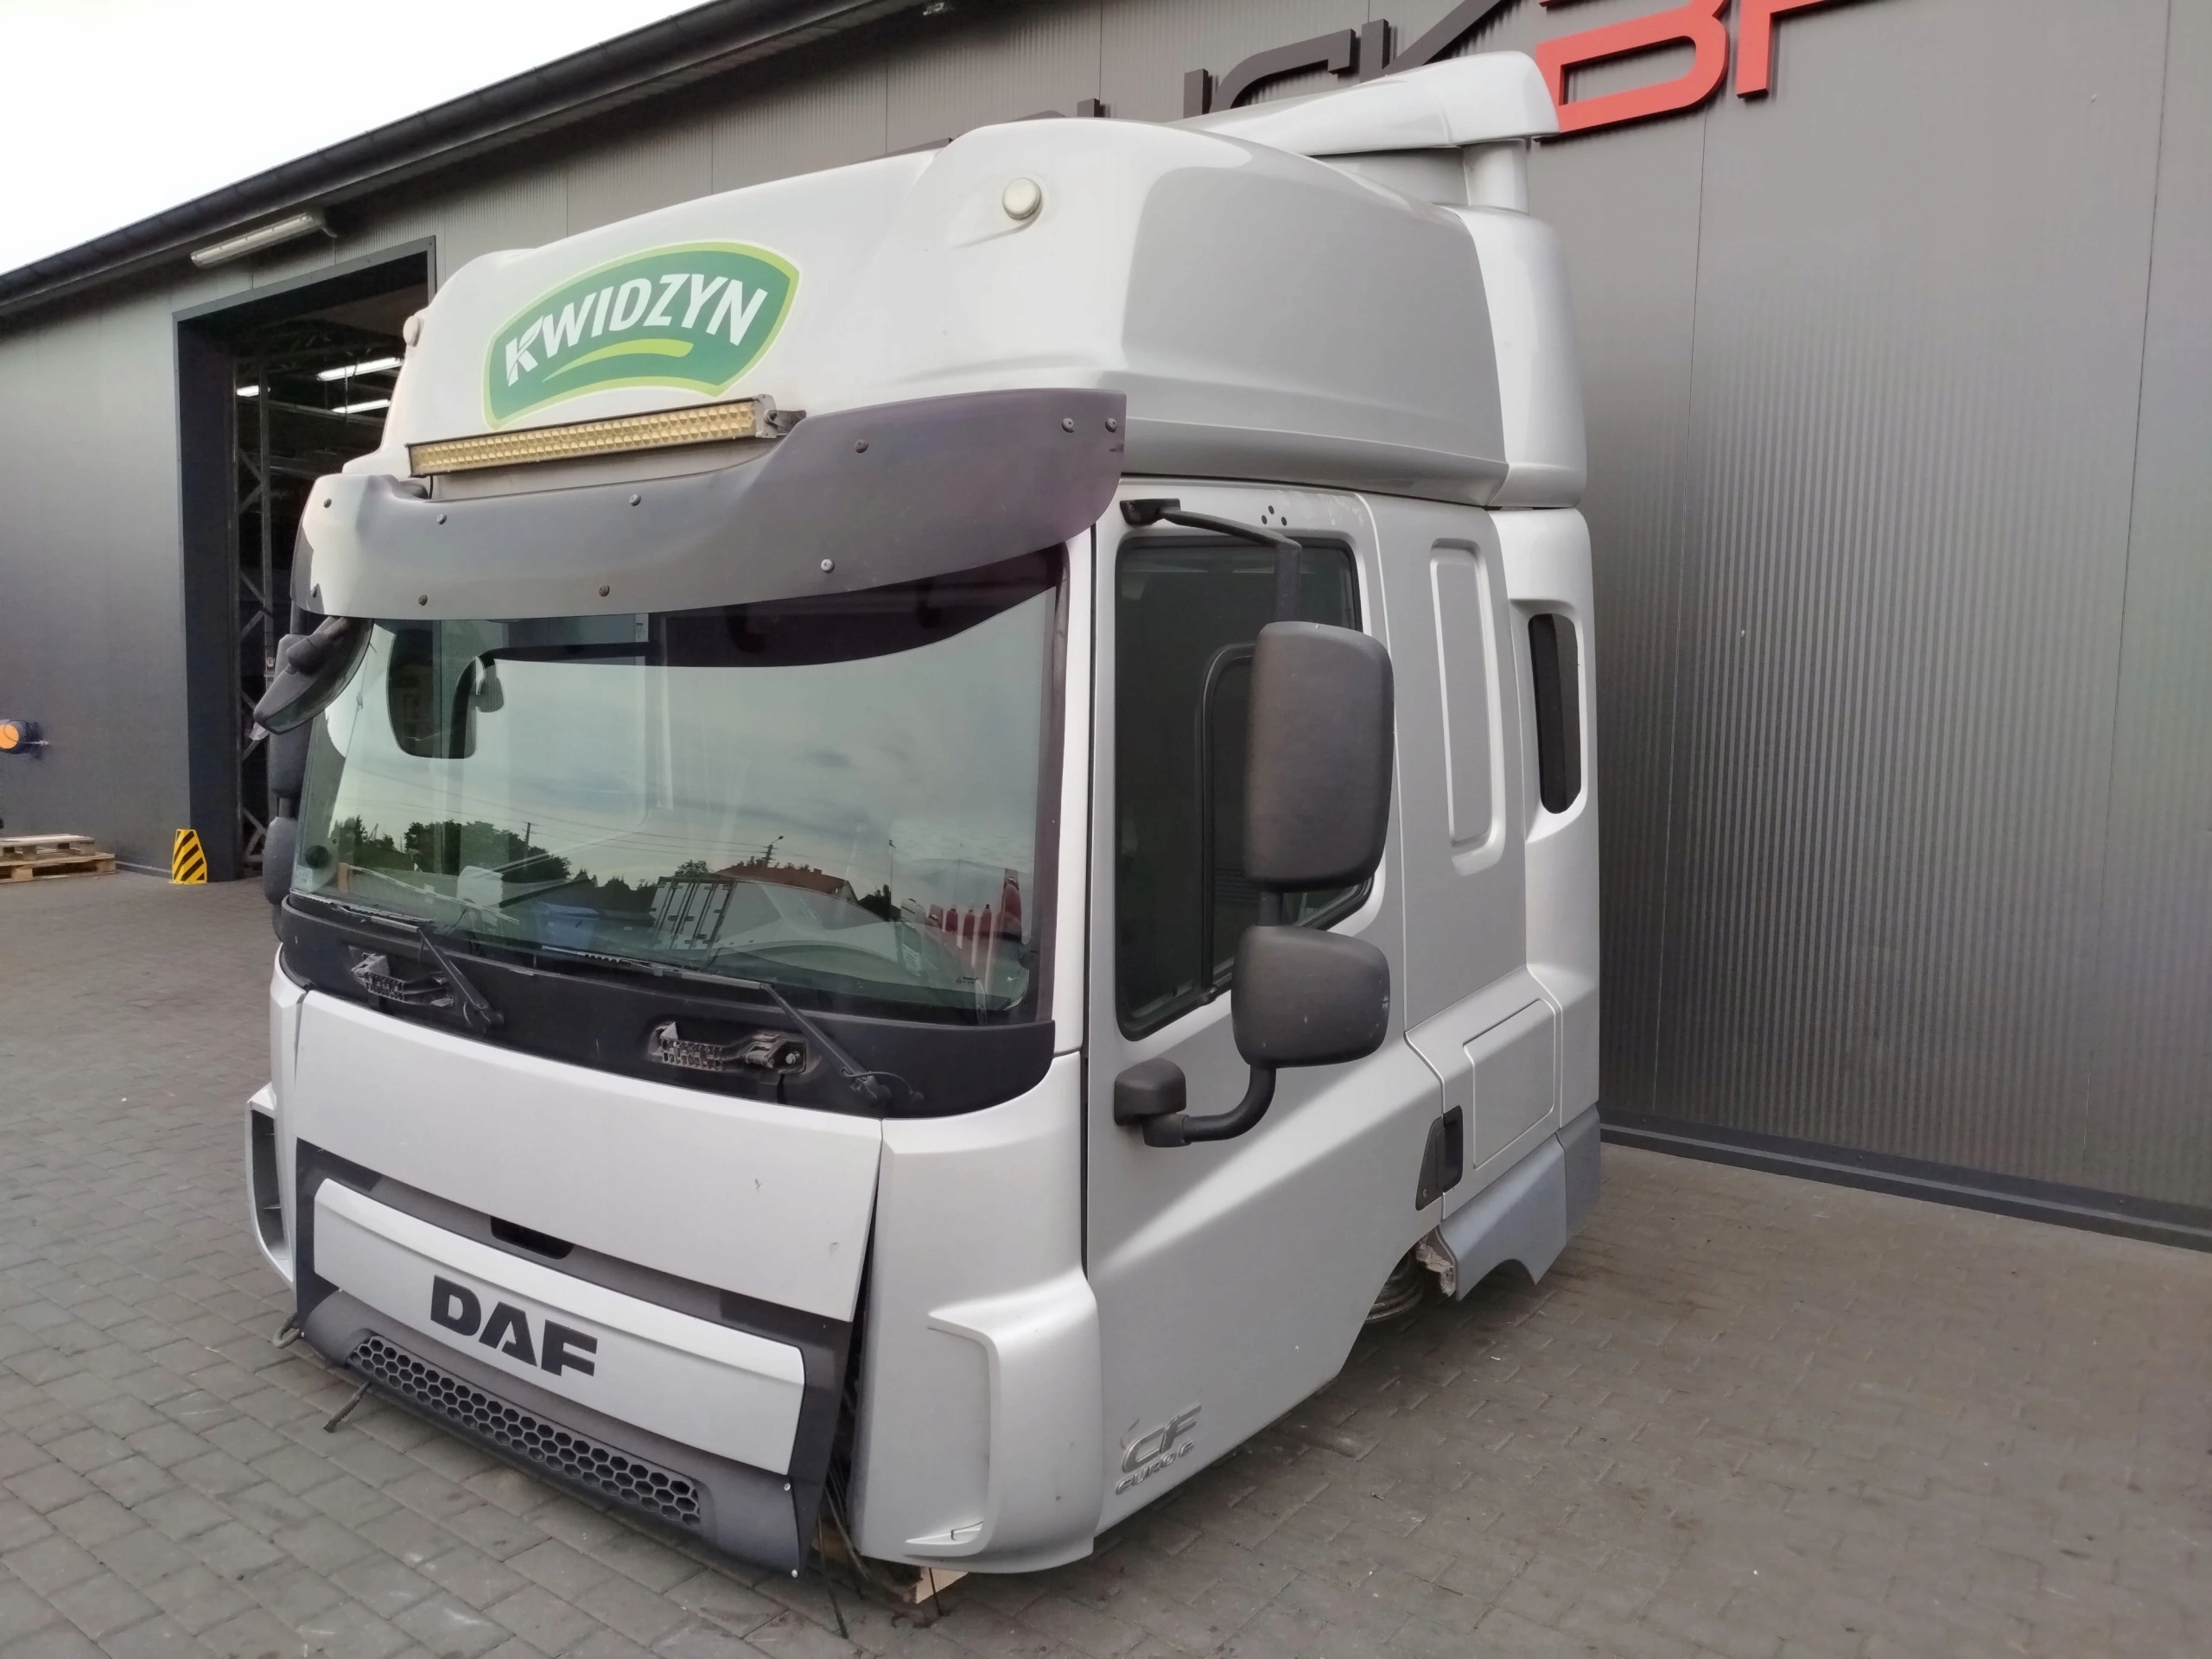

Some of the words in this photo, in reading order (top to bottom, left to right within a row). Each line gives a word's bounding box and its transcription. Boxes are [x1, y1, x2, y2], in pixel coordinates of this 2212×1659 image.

[505, 273, 768, 386] KWIDZYN
[430, 1274, 598, 1376] DAF
[1122, 1404, 1202, 1472] CF
